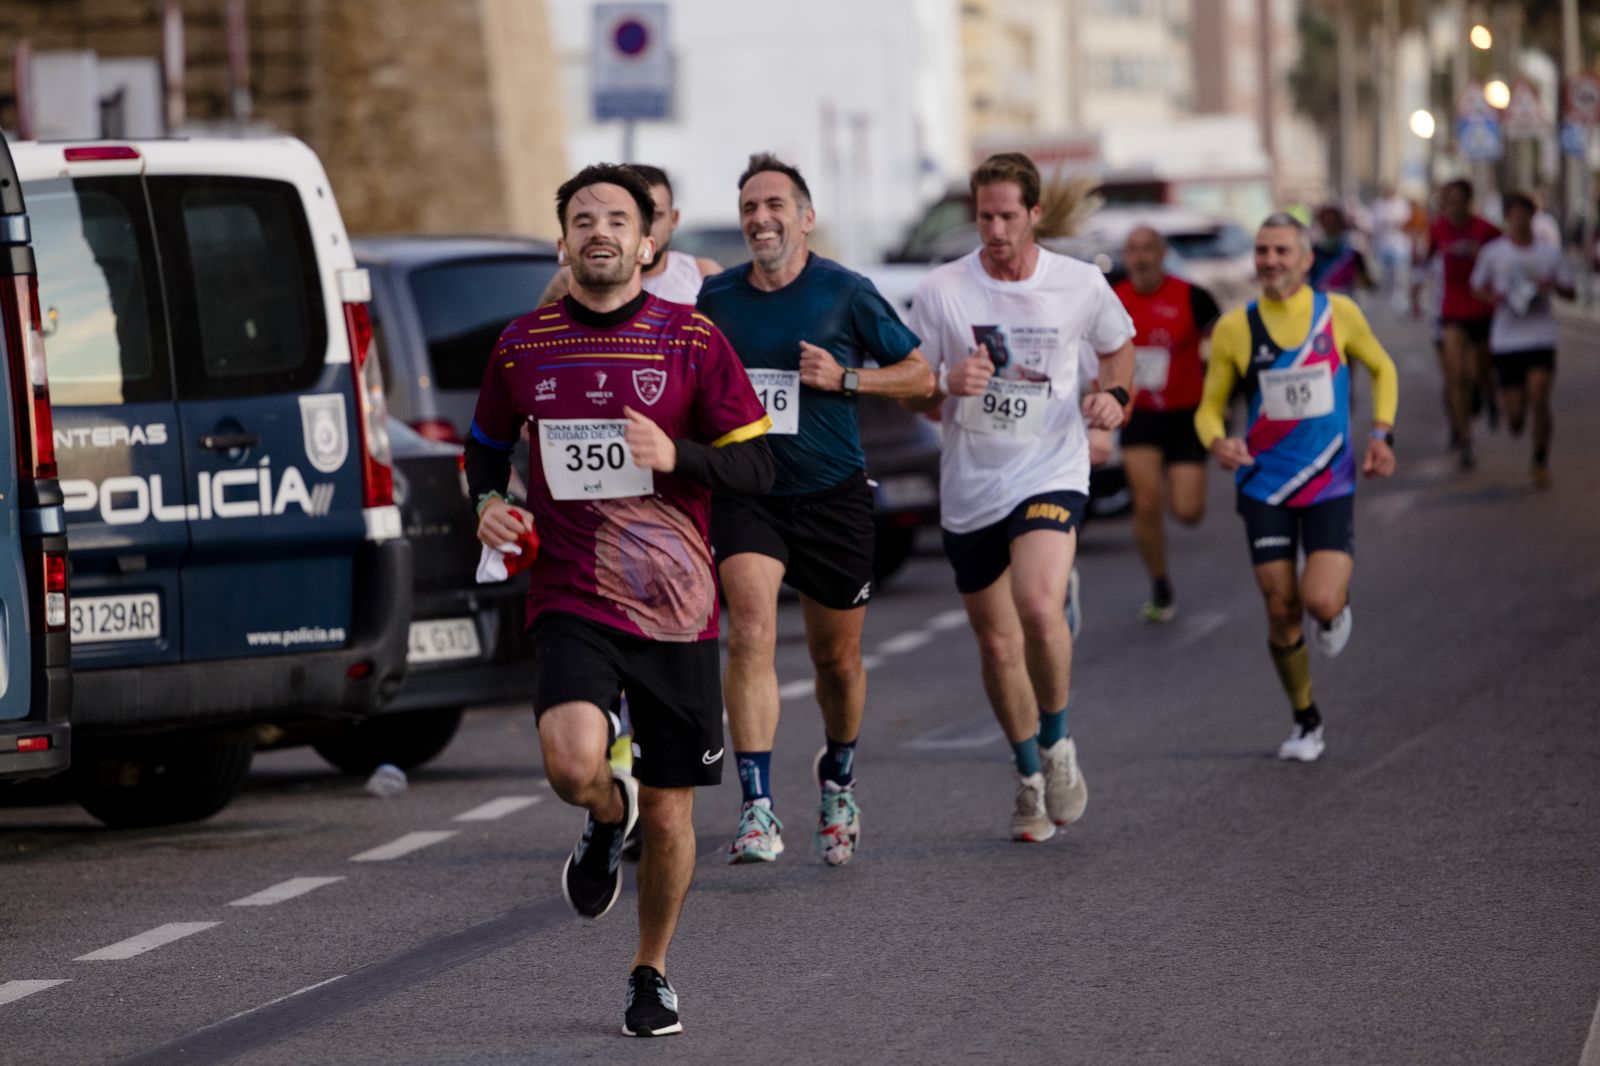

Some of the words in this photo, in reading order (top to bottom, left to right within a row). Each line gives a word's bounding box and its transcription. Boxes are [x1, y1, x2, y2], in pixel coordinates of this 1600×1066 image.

[983, 393, 1027, 418] 949
[1285, 383, 1312, 406] 85
[545, 423, 571, 431] SAN
[547, 430, 588, 440] CIUDAD
[591, 430, 604, 440] DE
[565, 442, 625, 472] 350
[60, 454, 314, 526] POLICÍA
[1026, 502, 1071, 524] NAVY
